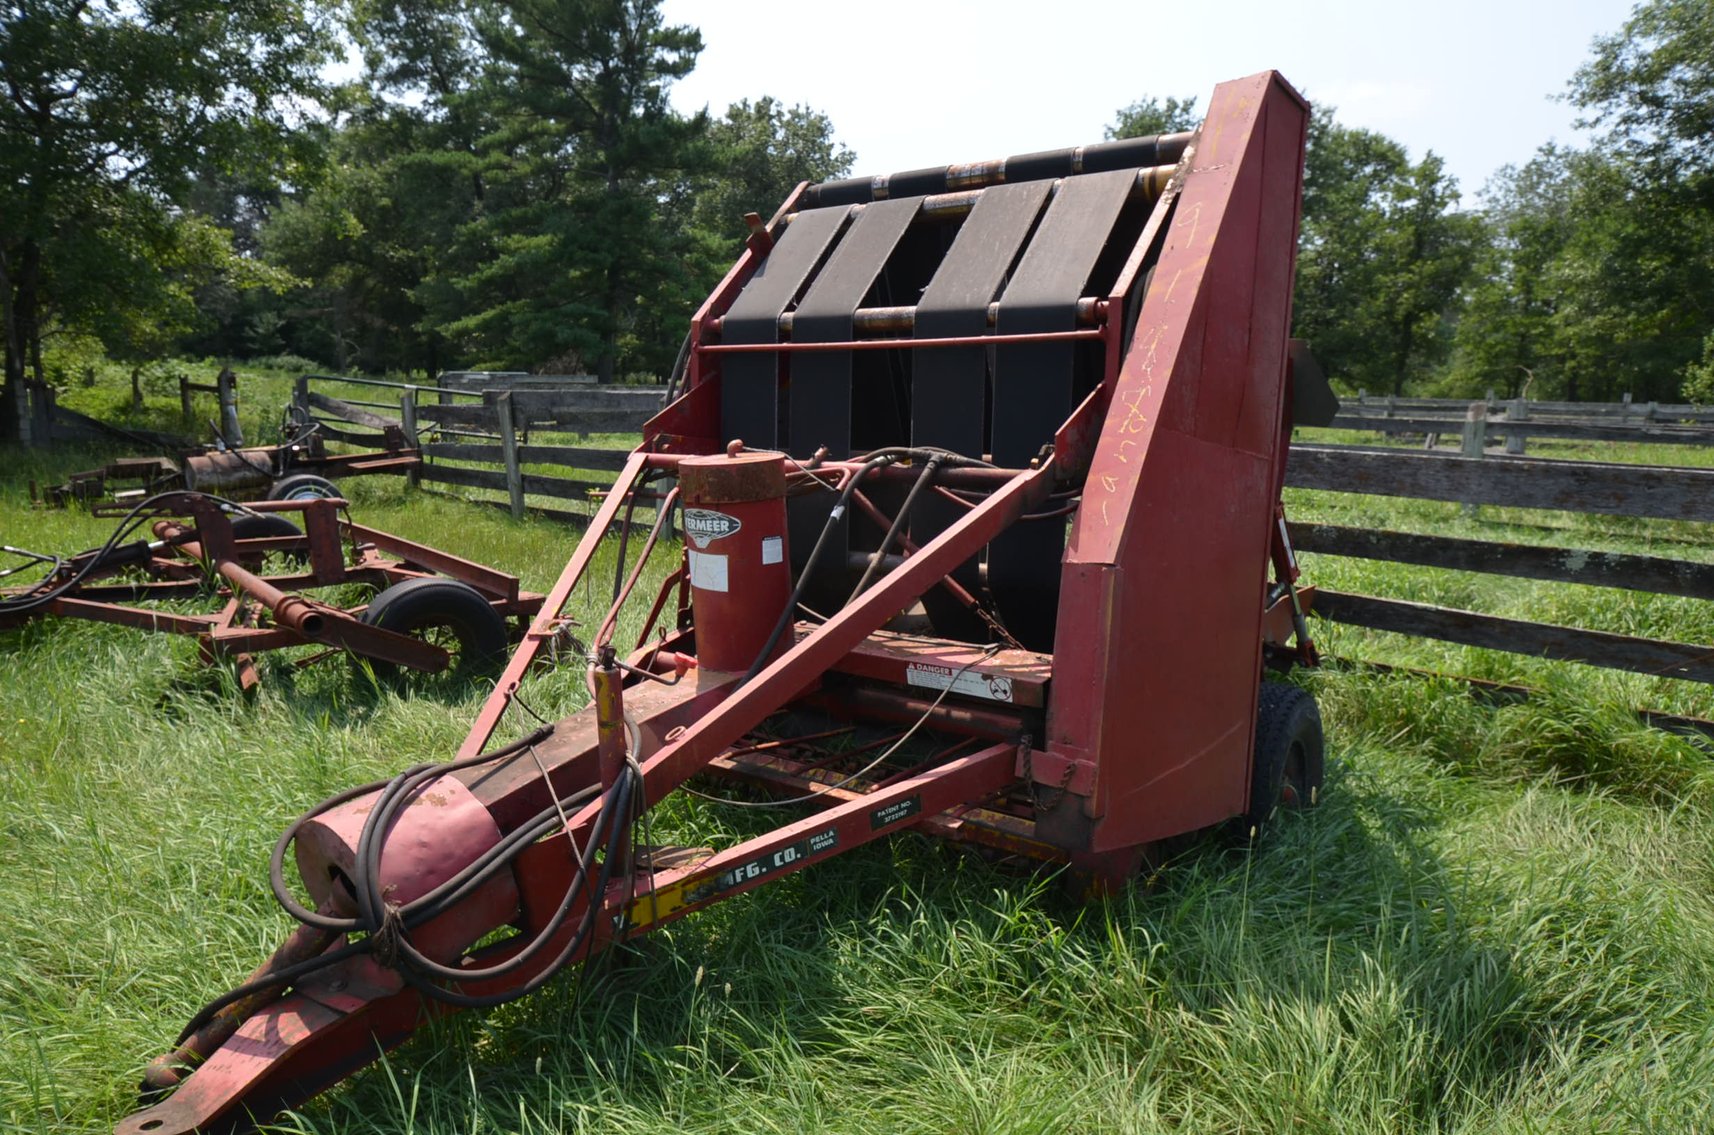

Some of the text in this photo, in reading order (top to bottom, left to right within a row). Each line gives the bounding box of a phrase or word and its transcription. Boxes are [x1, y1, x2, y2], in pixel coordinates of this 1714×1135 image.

[916, 663, 950, 675] DANGER
[877, 804, 899, 818] PATENT
[810, 830, 835, 845] PELLA
[813, 838, 835, 851] IOWA
[773, 847, 801, 867] CO.
